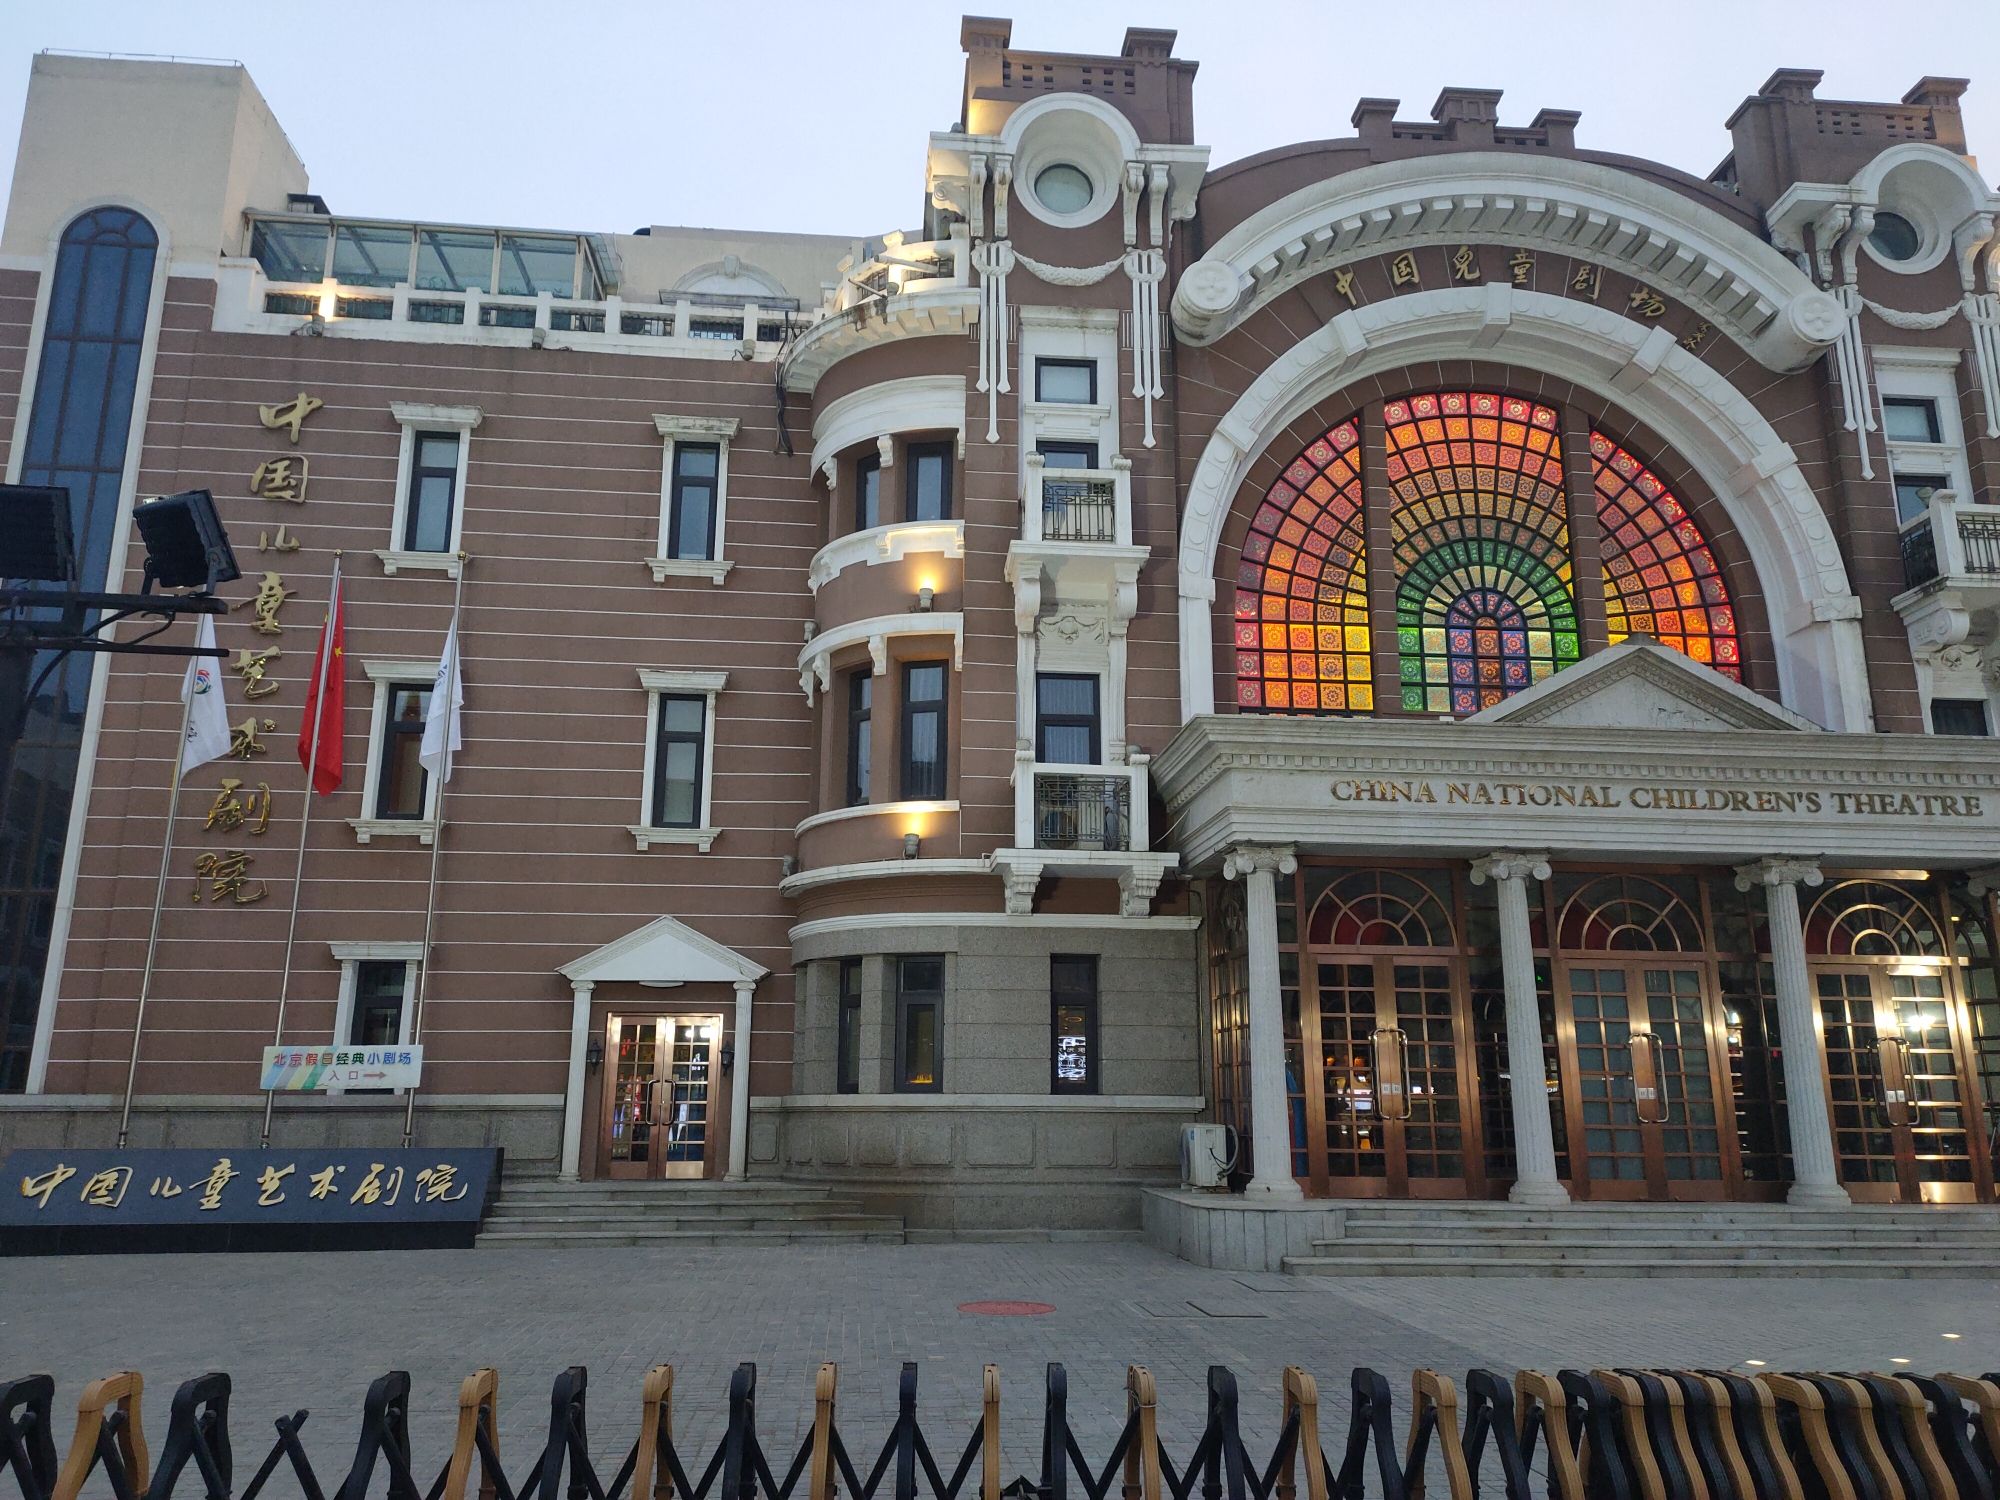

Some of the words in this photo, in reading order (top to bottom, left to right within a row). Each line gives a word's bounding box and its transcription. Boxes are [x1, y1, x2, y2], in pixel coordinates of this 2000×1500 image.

[192, 392, 324, 903] 中国儿童艺术剧院
[1330, 779, 1437, 803] CHINA
[1446, 782, 1621, 808] NATIONAL
[1629, 787, 1820, 813] CHILDREN'S
[1831, 792, 1984, 817] THEATRE
[274, 1052, 412, 1067] 北京假日经典小剧场
[21, 1157, 469, 1211] 中国儿童艺术剧院
